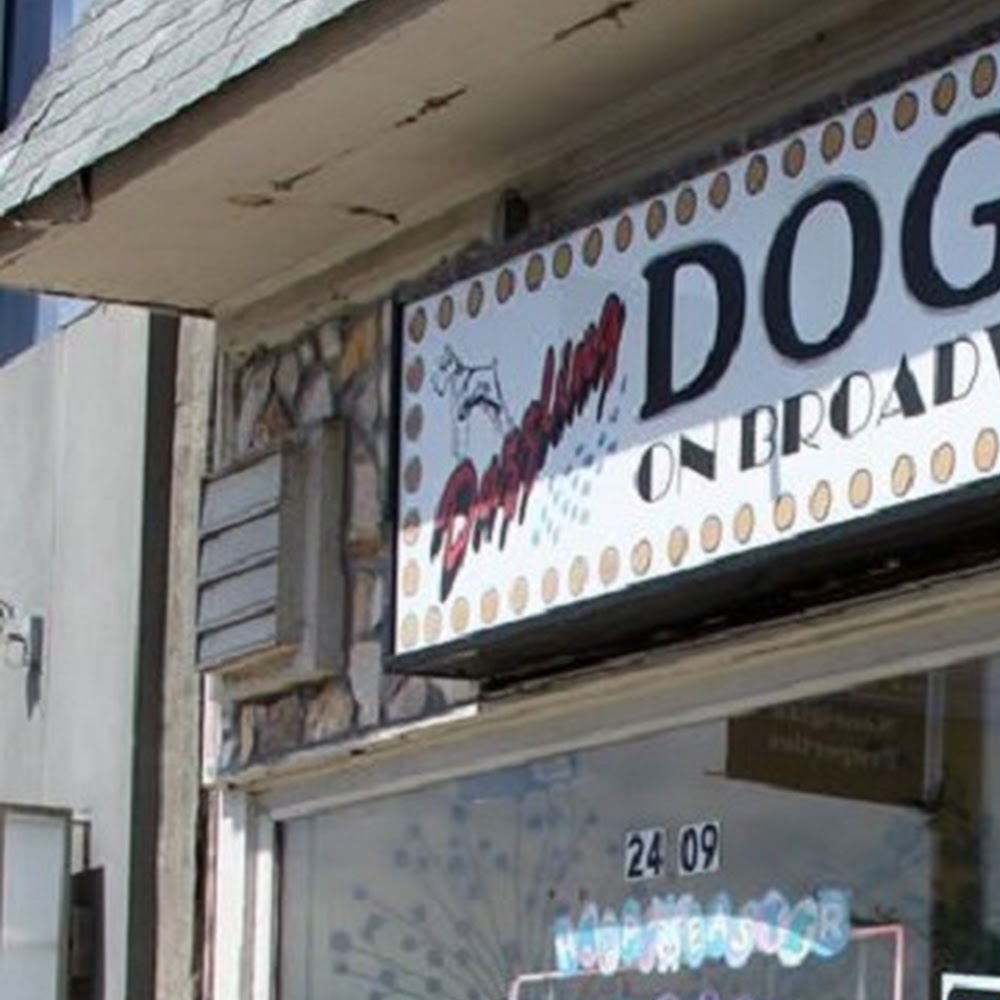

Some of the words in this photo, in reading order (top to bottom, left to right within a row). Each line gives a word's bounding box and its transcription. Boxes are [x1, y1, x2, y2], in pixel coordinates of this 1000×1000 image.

[634, 417, 718, 504] ON
[627, 832, 661, 878] 24
[680, 823, 718, 872] 09
